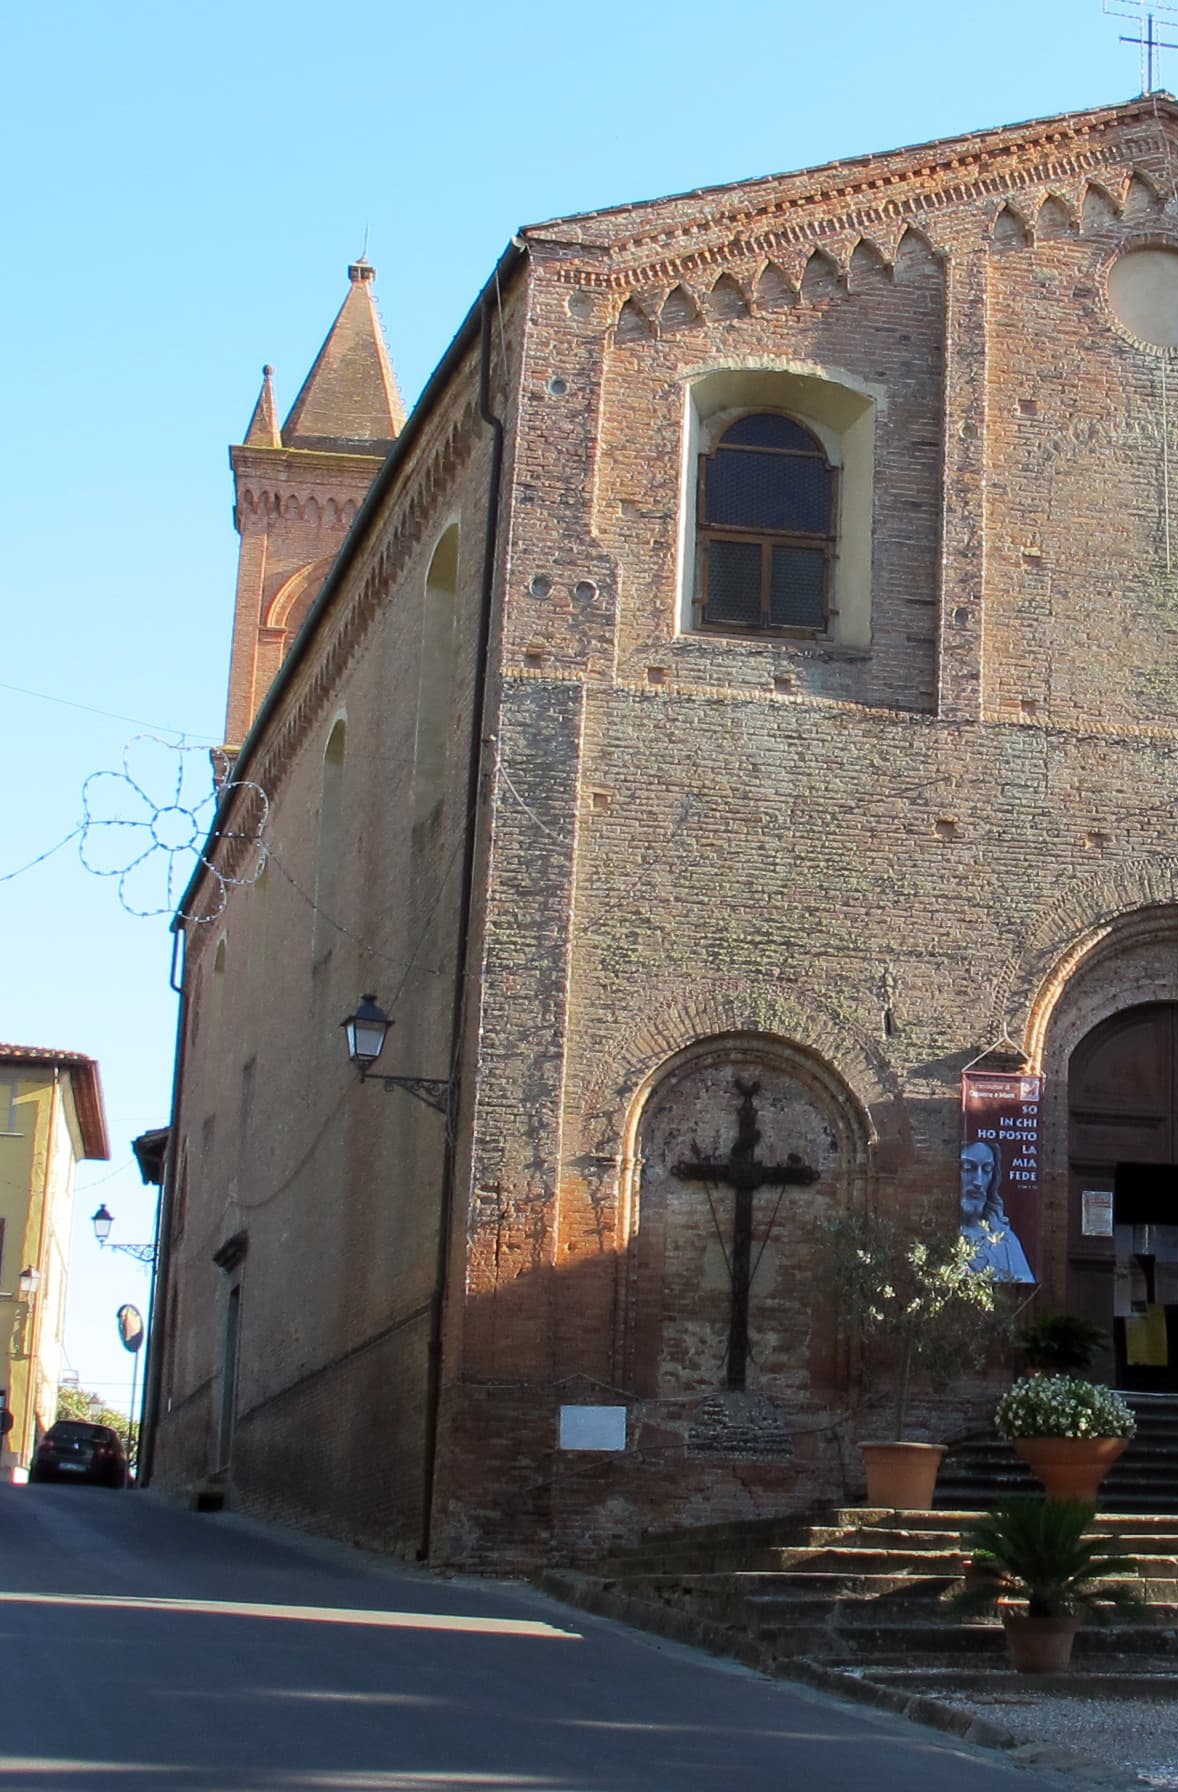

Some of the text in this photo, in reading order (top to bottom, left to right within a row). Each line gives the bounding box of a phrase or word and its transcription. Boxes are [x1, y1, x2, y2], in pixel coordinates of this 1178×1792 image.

[1022, 1105, 1038, 1114] SO
[1000, 1116, 1038, 1127] IN CHI
[977, 1129, 1038, 1141] HO POSTO
[1022, 1145, 1037, 1154] LA
[1012, 1158, 1037, 1168] MIA
[1009, 1171, 1037, 1181] FEDE
